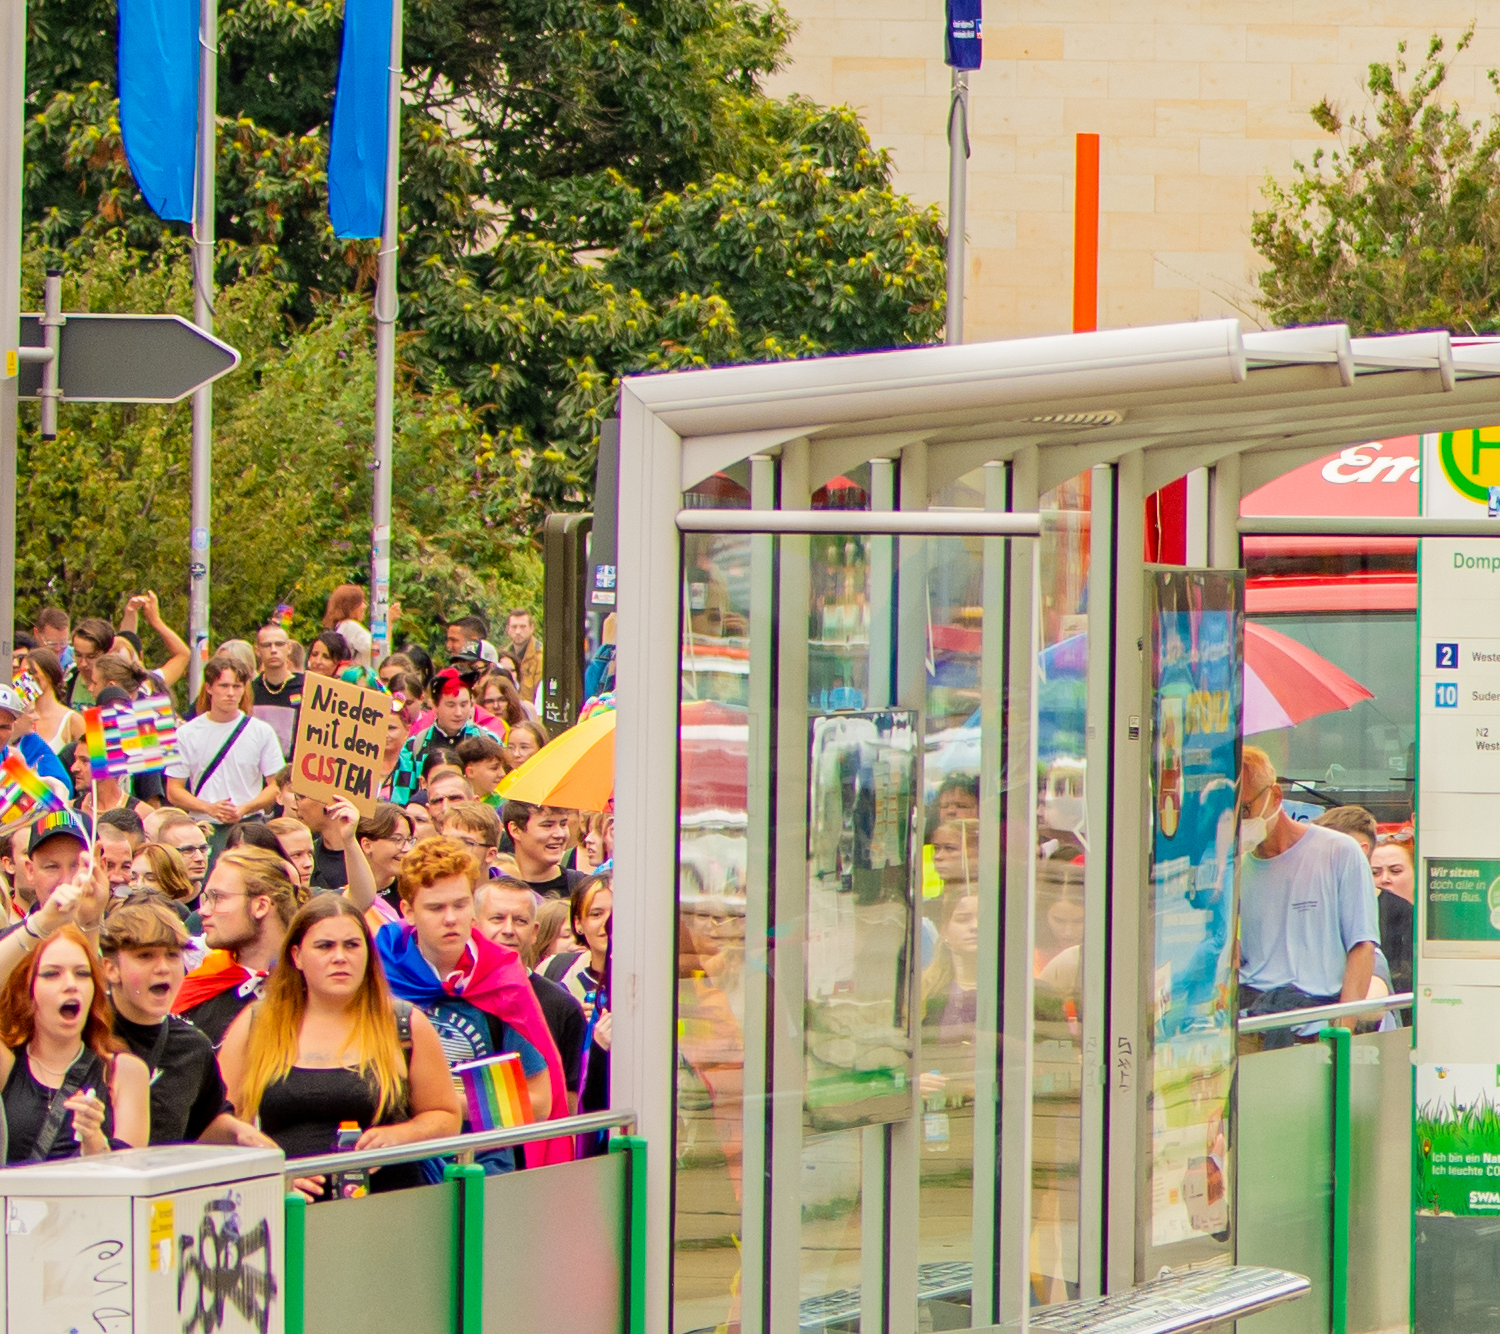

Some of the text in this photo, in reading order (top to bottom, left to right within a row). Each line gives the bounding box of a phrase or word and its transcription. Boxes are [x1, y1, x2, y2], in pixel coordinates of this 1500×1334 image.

[1441, 647, 1453, 665] 2
[1437, 687, 1456, 704] 10
[311, 684, 384, 727] Nieder
[306, 718, 380, 760] mit dem
[1476, 727, 1489, 739] N2
[301, 752, 373, 799] CISTEM
[1430, 867, 1480, 877] Wir sitzen
[1430, 879, 1454, 890] doch
[1455, 879, 1475, 889] alle
[1476, 879, 1486, 889] in
[1430, 892, 1459, 902] einem
[1460, 892, 1482, 902] Bus.
[1432, 1152, 1447, 1163] Ich
[1448, 1152, 1463, 1163] bin
[1465, 1153, 1480, 1163] ein
[1432, 1165, 1447, 1175] Ich
[1448, 1165, 1483, 1176] leuchte
[1469, 1191, 1500, 1203] SWM
